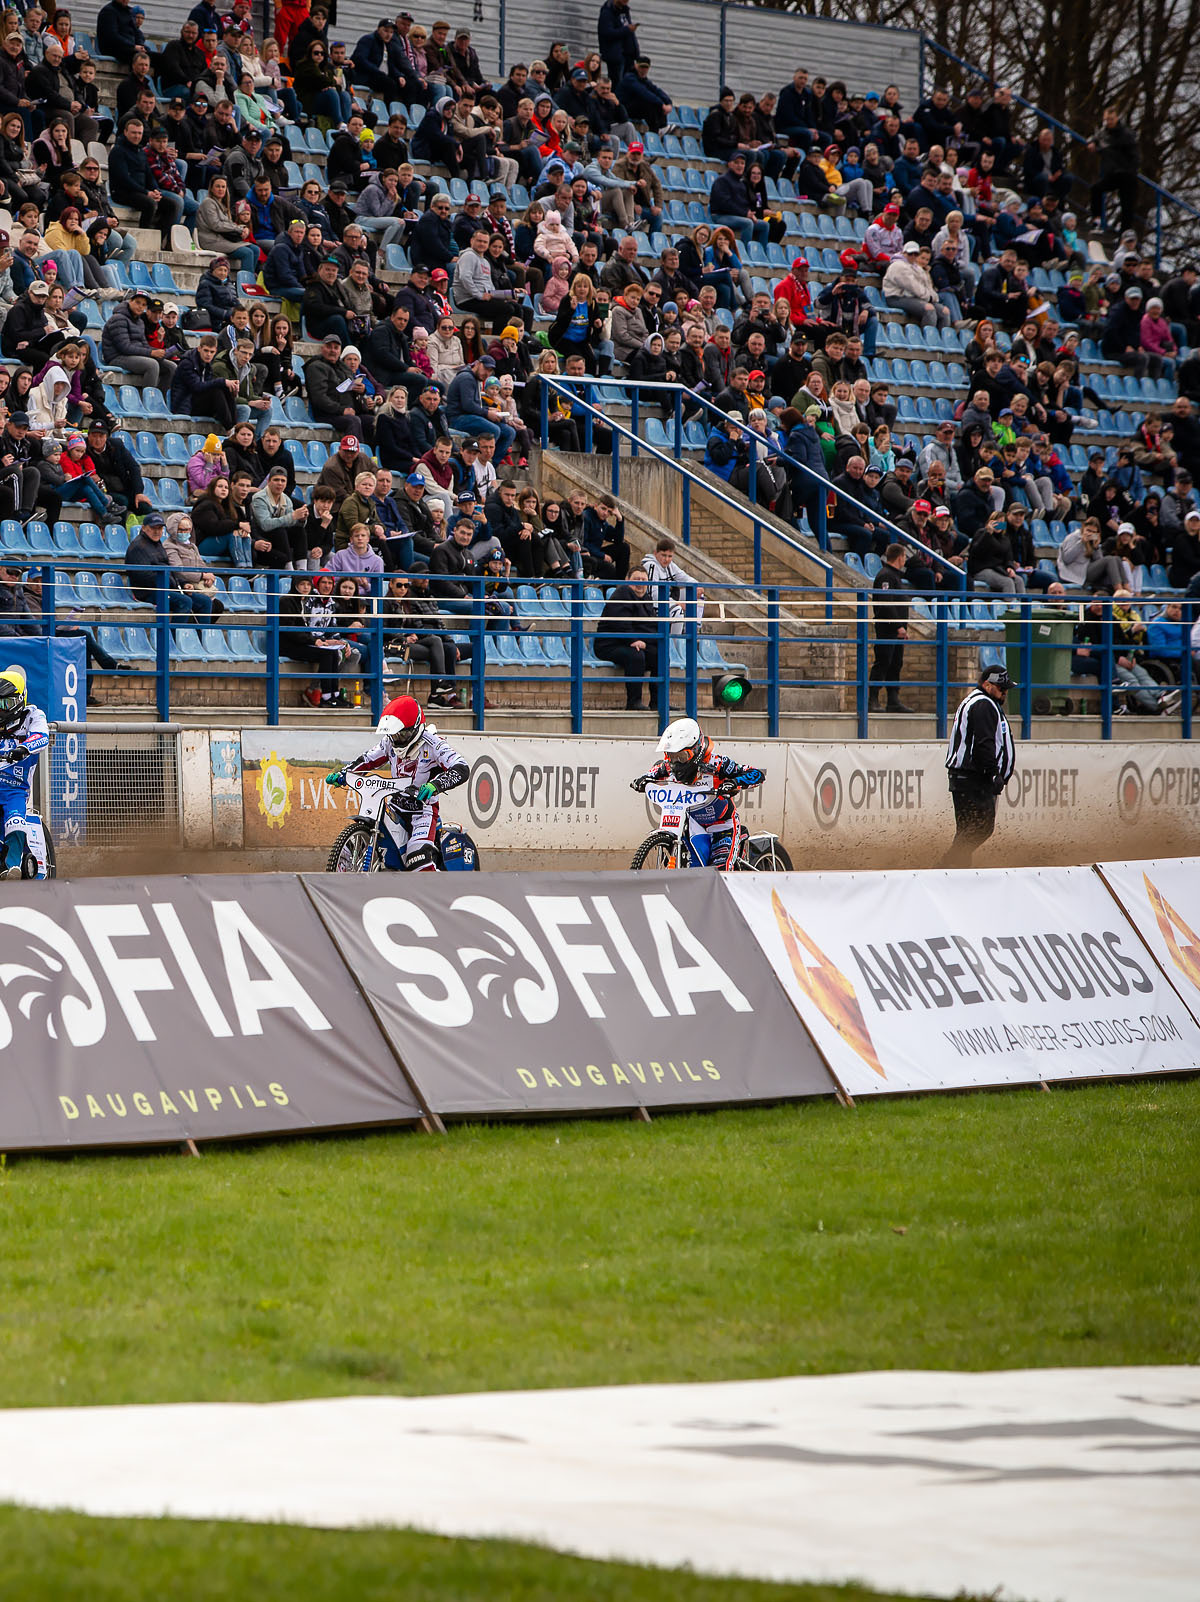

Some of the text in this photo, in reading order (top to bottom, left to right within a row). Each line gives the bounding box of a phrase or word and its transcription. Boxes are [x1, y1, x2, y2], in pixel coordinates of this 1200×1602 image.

[300, 778, 361, 810] LVK A
[365, 780, 396, 790] OPTIBET
[509, 764, 600, 808] OPTIBET
[849, 769, 924, 810] OPTIBET
[1005, 769, 1078, 808] OPTIBET
[362, 894, 754, 1029] SOFIA
[850, 930, 1155, 1012] AMBER STUDIOS
[943, 1015, 1183, 1058] WWW.AMBER-STUDIOS.COM
[516, 1060, 722, 1089] DAUGAVPILS
[58, 1081, 292, 1120] DAUGAVPILS
